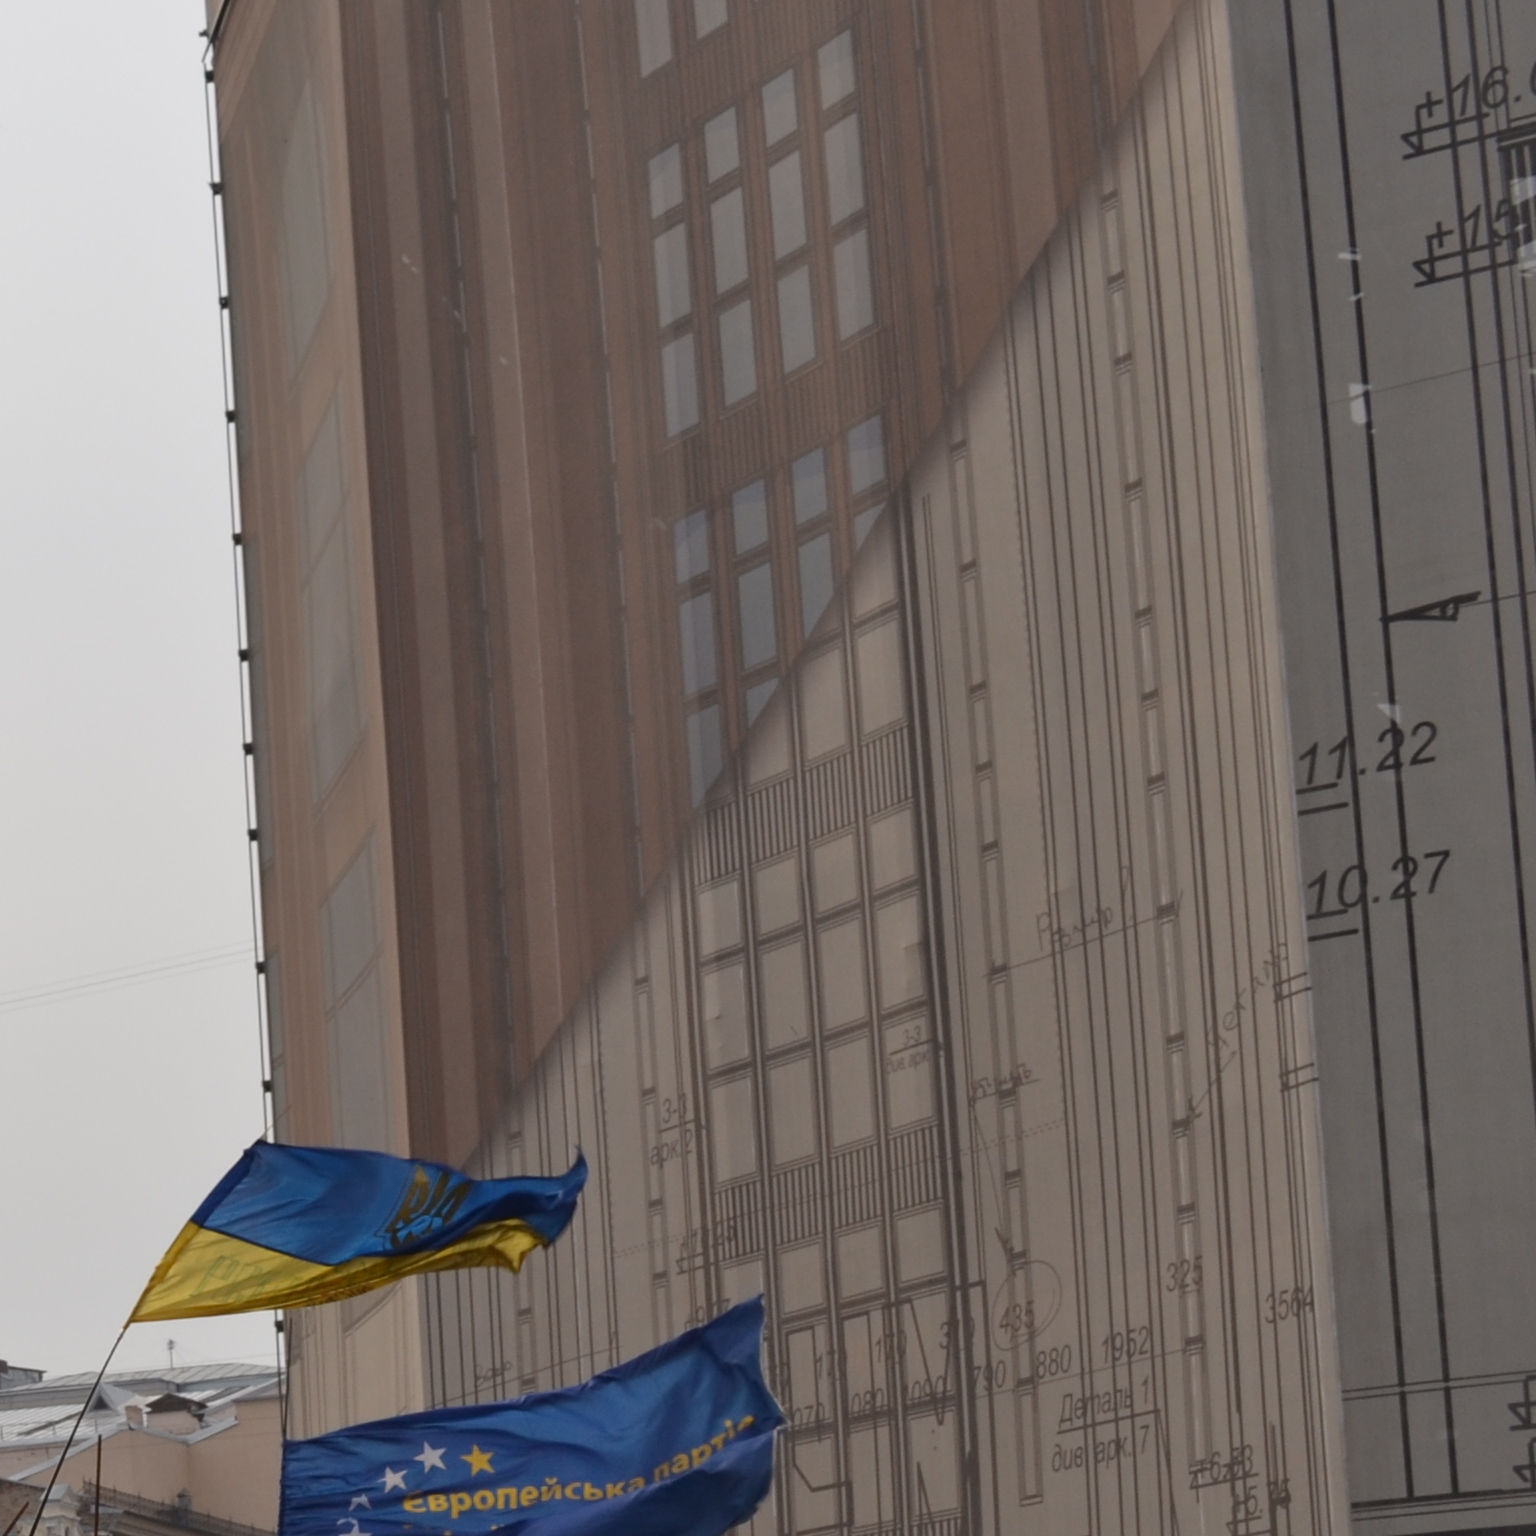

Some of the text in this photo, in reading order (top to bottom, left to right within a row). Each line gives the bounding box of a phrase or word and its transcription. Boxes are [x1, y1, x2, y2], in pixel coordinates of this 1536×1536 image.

[1421, 64, 1536, 118] +16.
[1298, 720, 1438, 786] 11.22
[1307, 849, 1451, 916] 10.27
[1035, 1344, 1073, 1379] 880
[1102, 1325, 1150, 1364] 1952
[402, 1475, 646, 1519] Європейська
